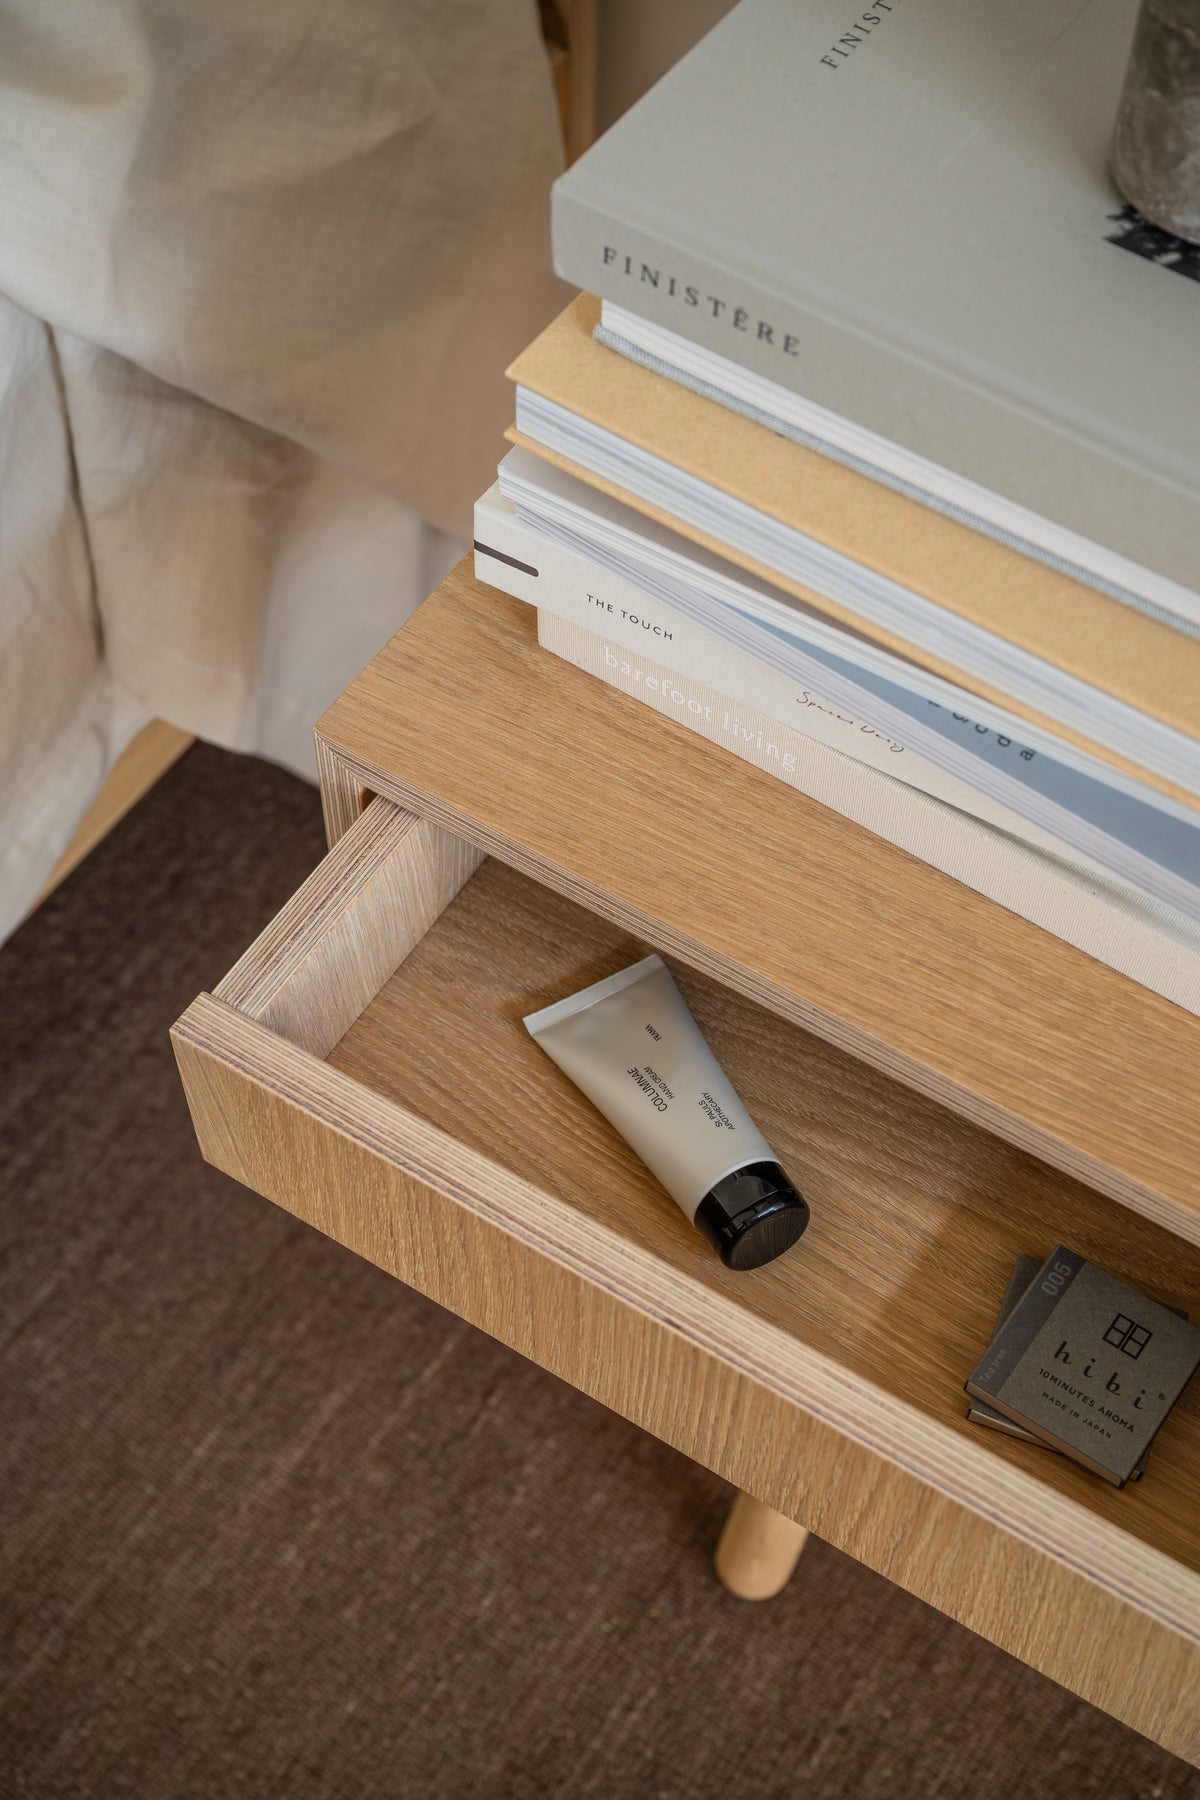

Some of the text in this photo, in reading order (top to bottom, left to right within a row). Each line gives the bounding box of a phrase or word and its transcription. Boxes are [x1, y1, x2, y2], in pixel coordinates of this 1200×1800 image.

[603, 245, 800, 357] FINISTÈRE
[586, 593, 674, 641] THE TOUCH
[604, 646, 712, 721] barefoot
[723, 712, 798, 773] living
[645, 1023, 662, 1042] FRAMA
[627, 1067, 668, 1112] COLUMNAE
[643, 1066, 676, 1100] HAND CREAM
[698, 1099, 716, 1120] PAULS
[701, 1091, 736, 1131] APOTHECARY
[1041, 1261, 1071, 1296] 005
[1053, 1340, 1147, 1411] hibi
[1038, 1367, 1135, 1433] 10MINUTES AROMA
[1041, 1391, 1113, 1440] MADE IN JAPAN
